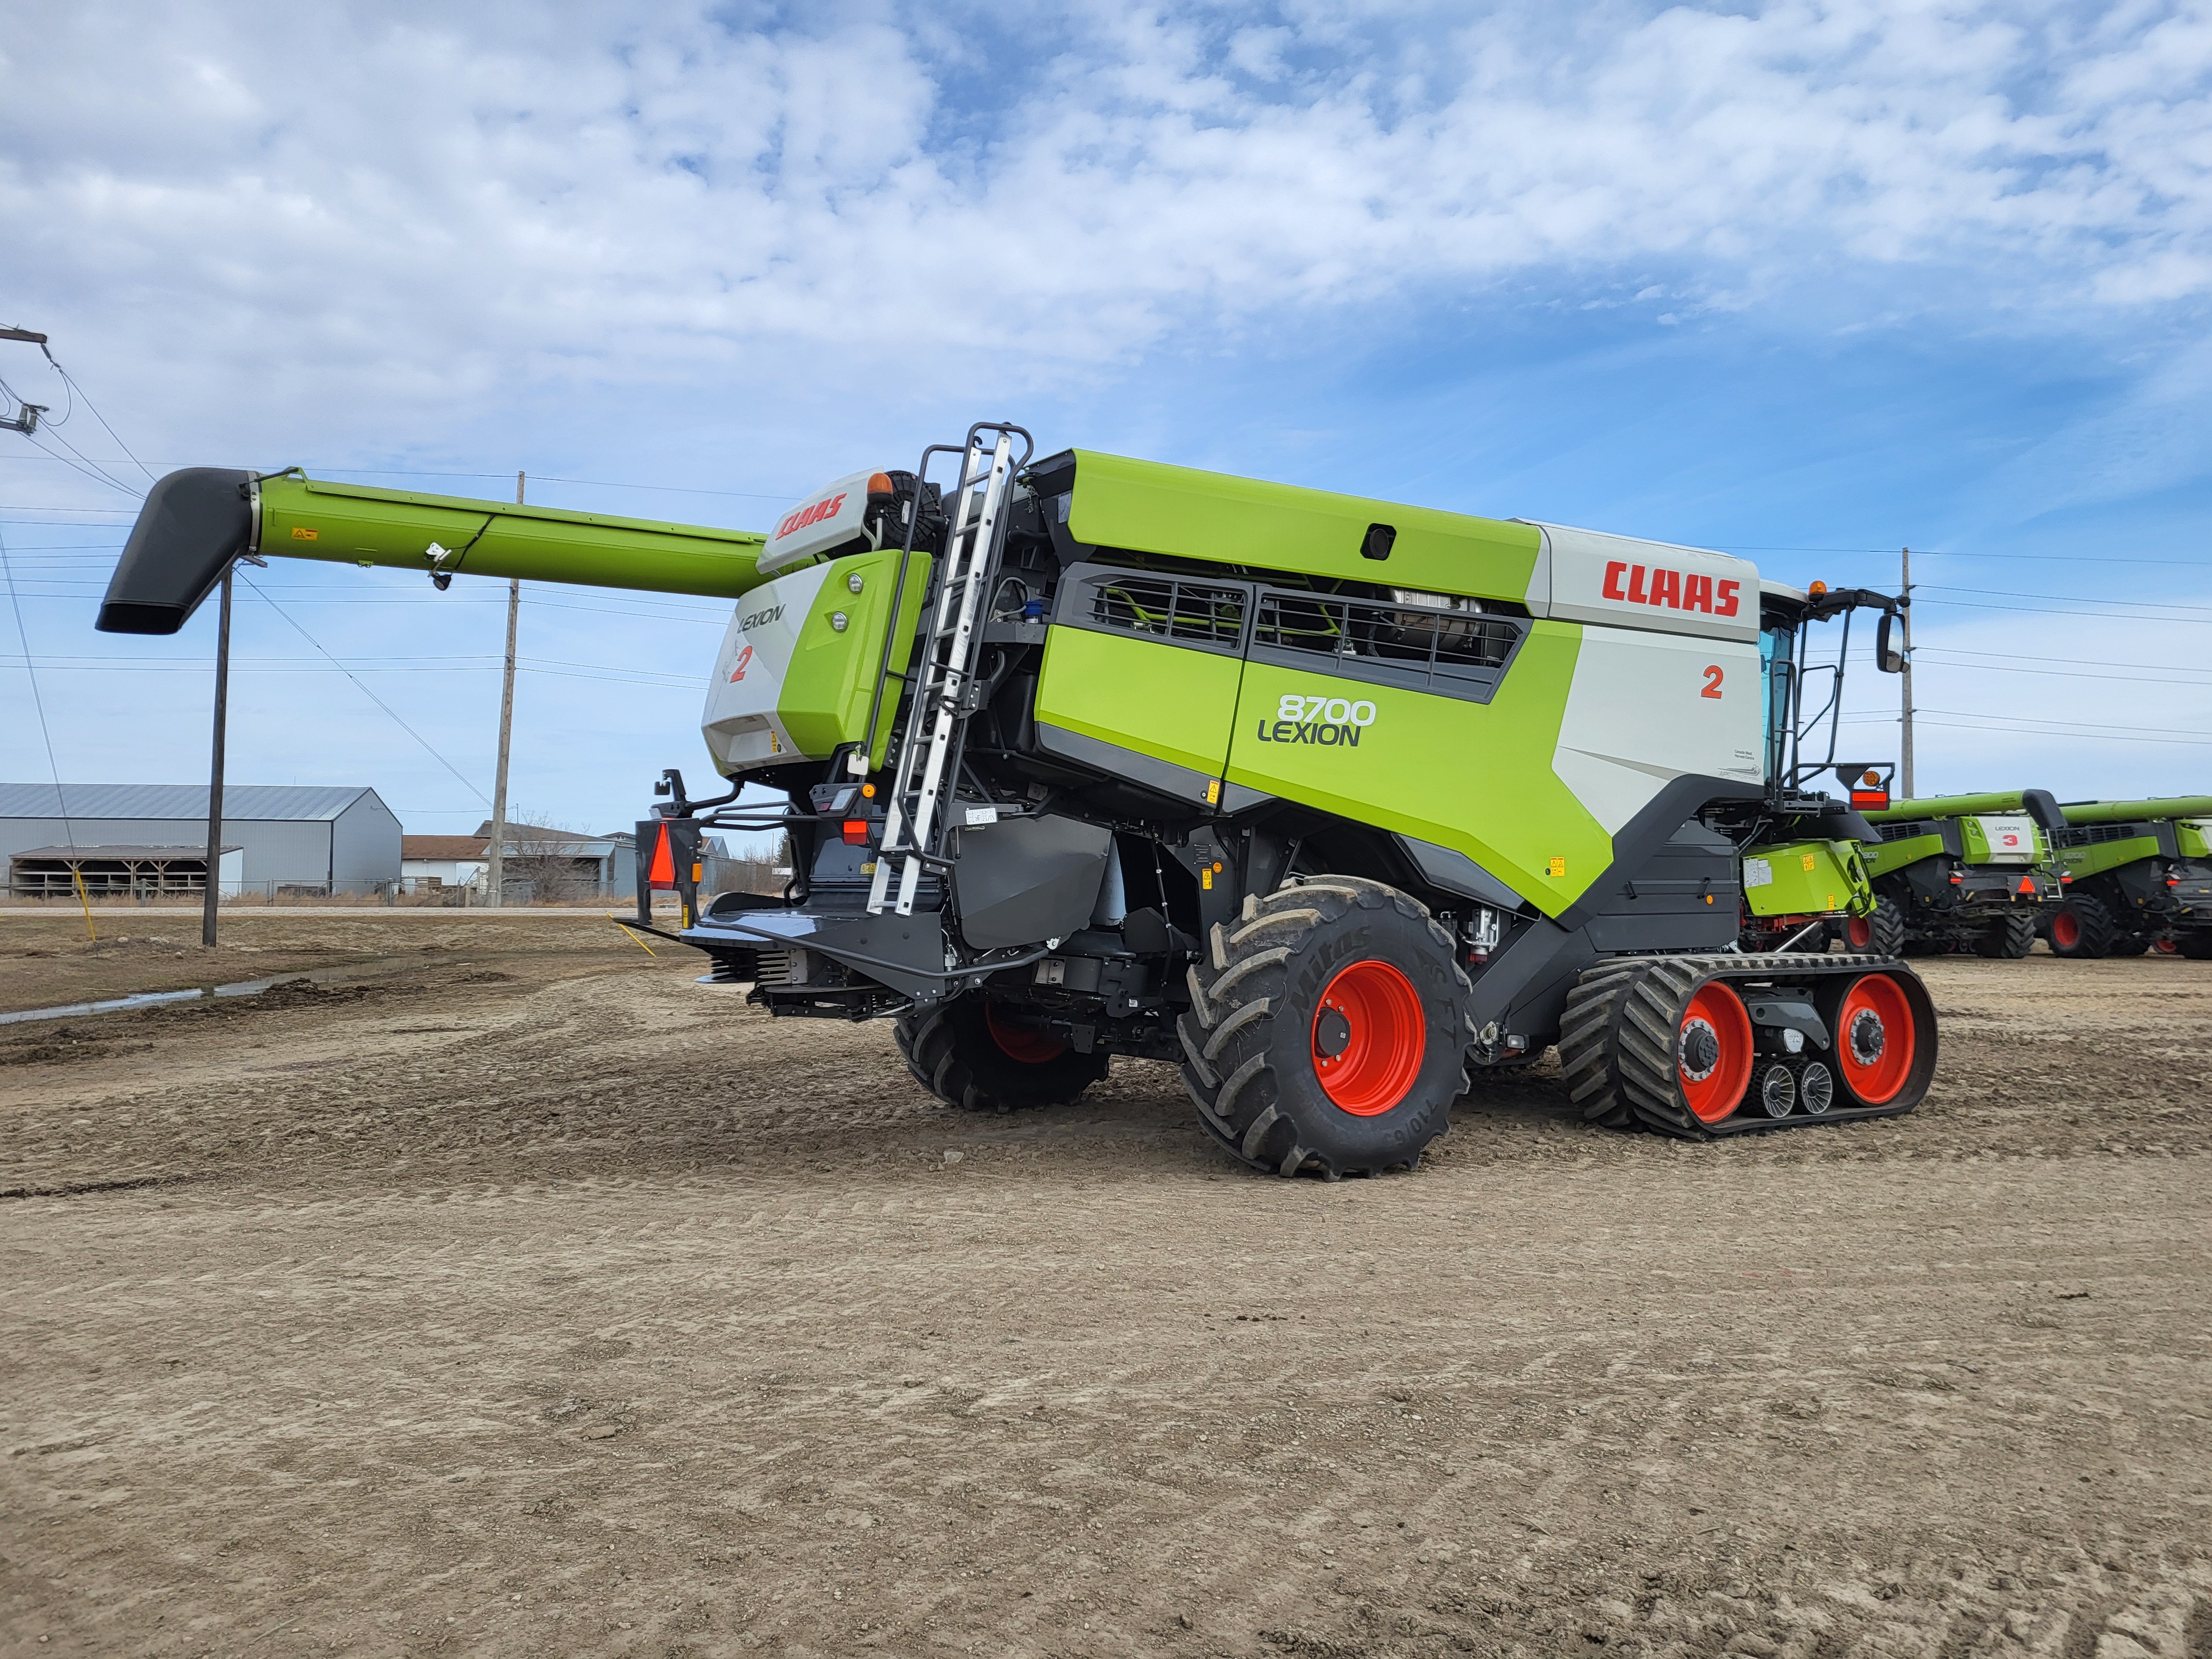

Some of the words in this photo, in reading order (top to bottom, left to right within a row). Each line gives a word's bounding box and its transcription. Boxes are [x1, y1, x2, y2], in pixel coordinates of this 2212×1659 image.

[775, 493, 847, 540] CLAAS
[1602, 560, 1740, 617] CLAAS
[737, 603, 786, 634] LEXION
[729, 645, 753, 684] 2
[1700, 665, 1724, 699] 2
[1277, 695, 1376, 727] 8700
[1257, 719, 1361, 747] LEXION
[2002, 834, 2018, 846] 3
[1291, 925, 1373, 1027] Mitas
